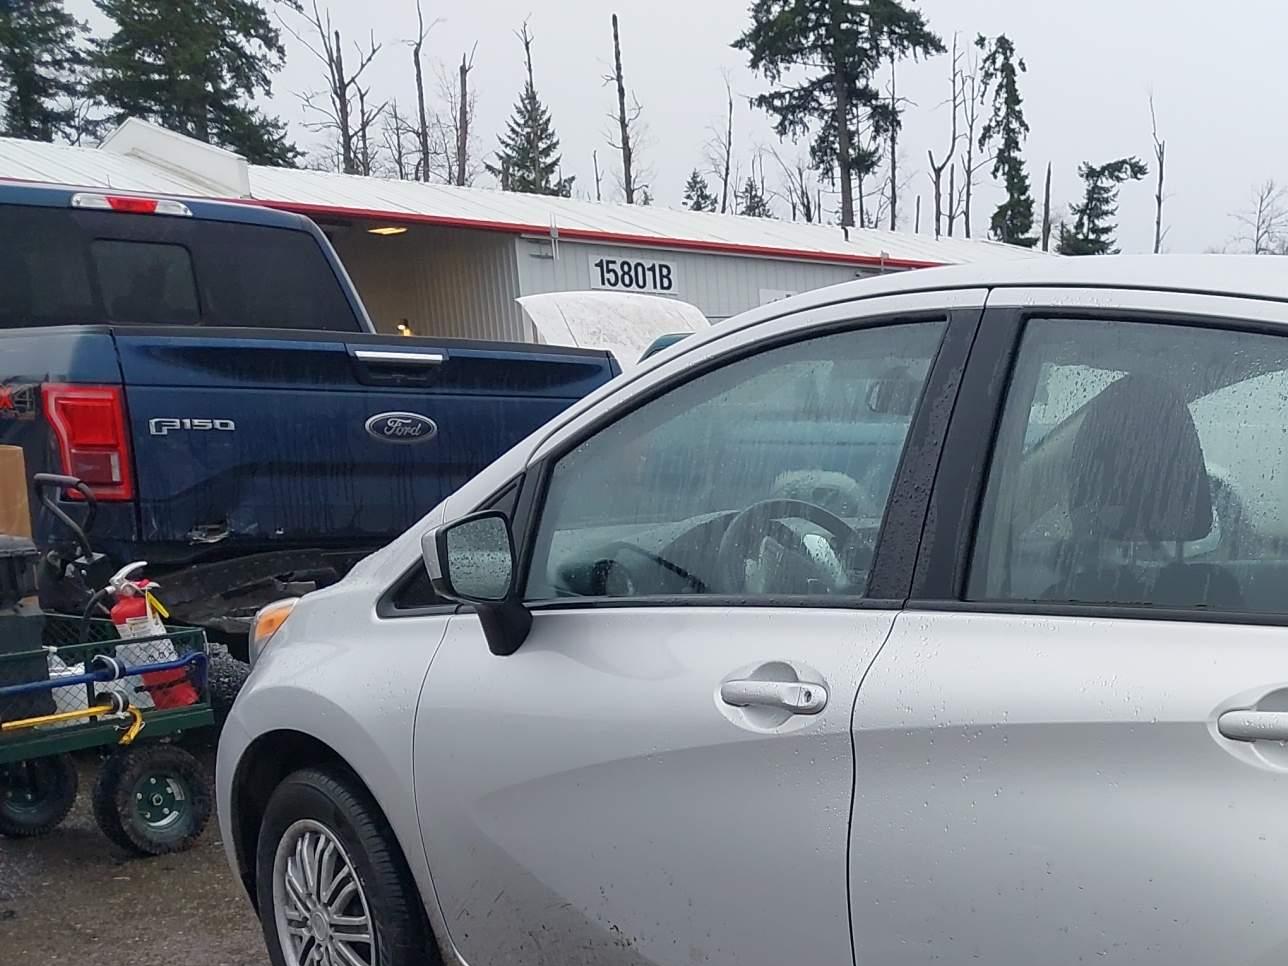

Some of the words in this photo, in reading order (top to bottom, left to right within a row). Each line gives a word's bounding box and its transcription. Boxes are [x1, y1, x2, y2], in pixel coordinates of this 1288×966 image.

[594, 258, 673, 291] 15801B
[149, 418, 236, 435] F150
[383, 418, 422, 436] Ford
